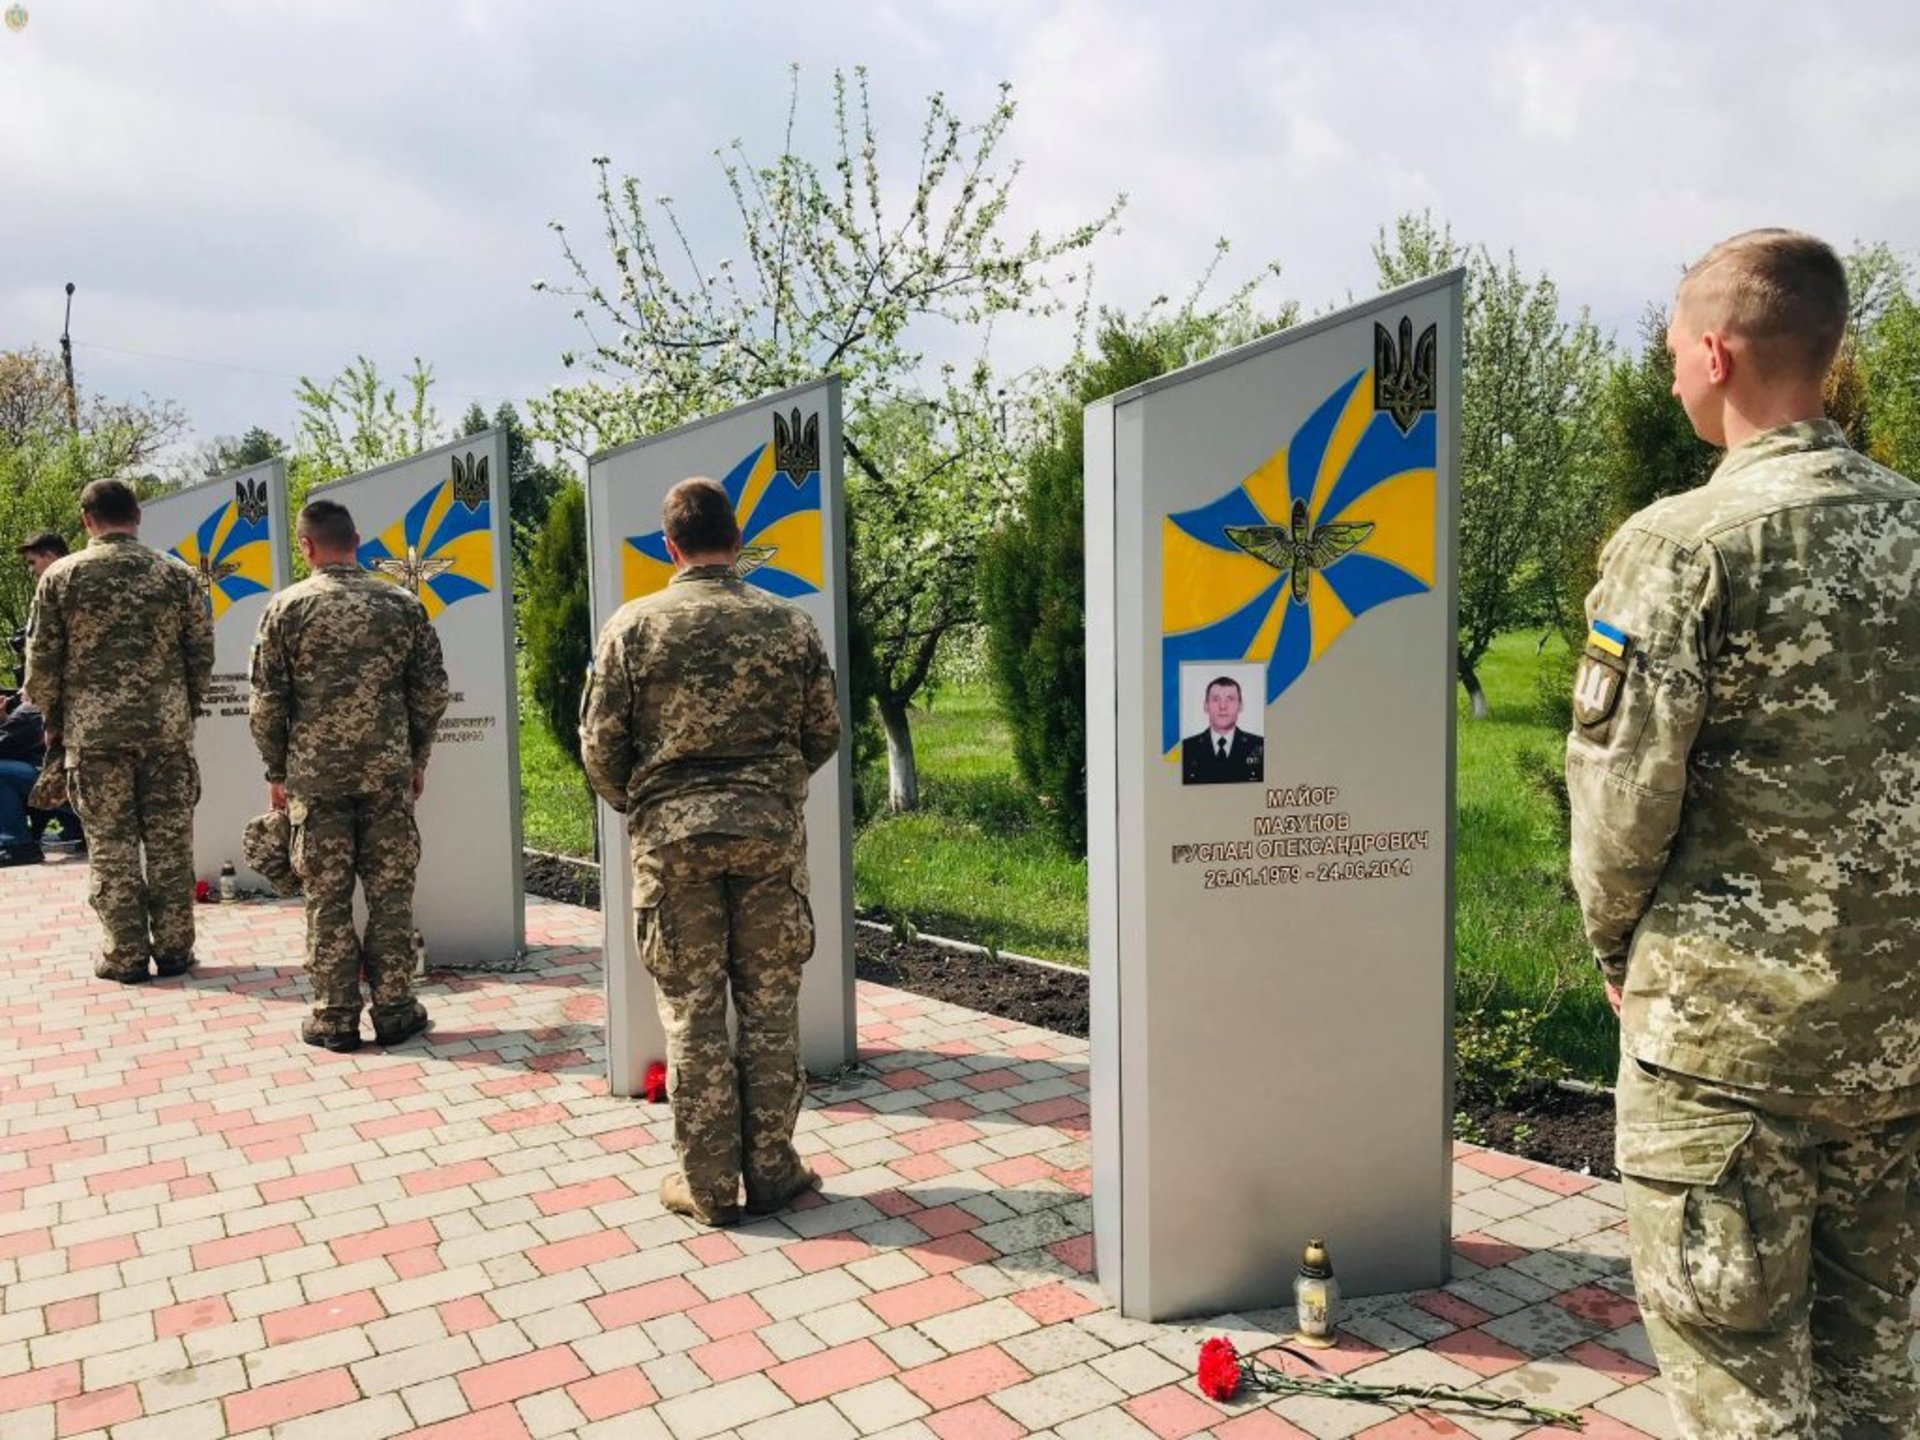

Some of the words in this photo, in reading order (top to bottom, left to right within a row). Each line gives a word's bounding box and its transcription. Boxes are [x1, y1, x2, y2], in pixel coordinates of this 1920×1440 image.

[1266, 785, 1339, 808] МАЙОР
[1254, 812, 1350, 836] МАЗУНОВ
[1171, 841, 1253, 864] РУСЛАН
[1256, 830, 1430, 859] ОЛЕКСАНДРОВИЧ
[1204, 864, 1301, 889] 26.01.1979
[1317, 858, 1412, 882] 24.06.2014
